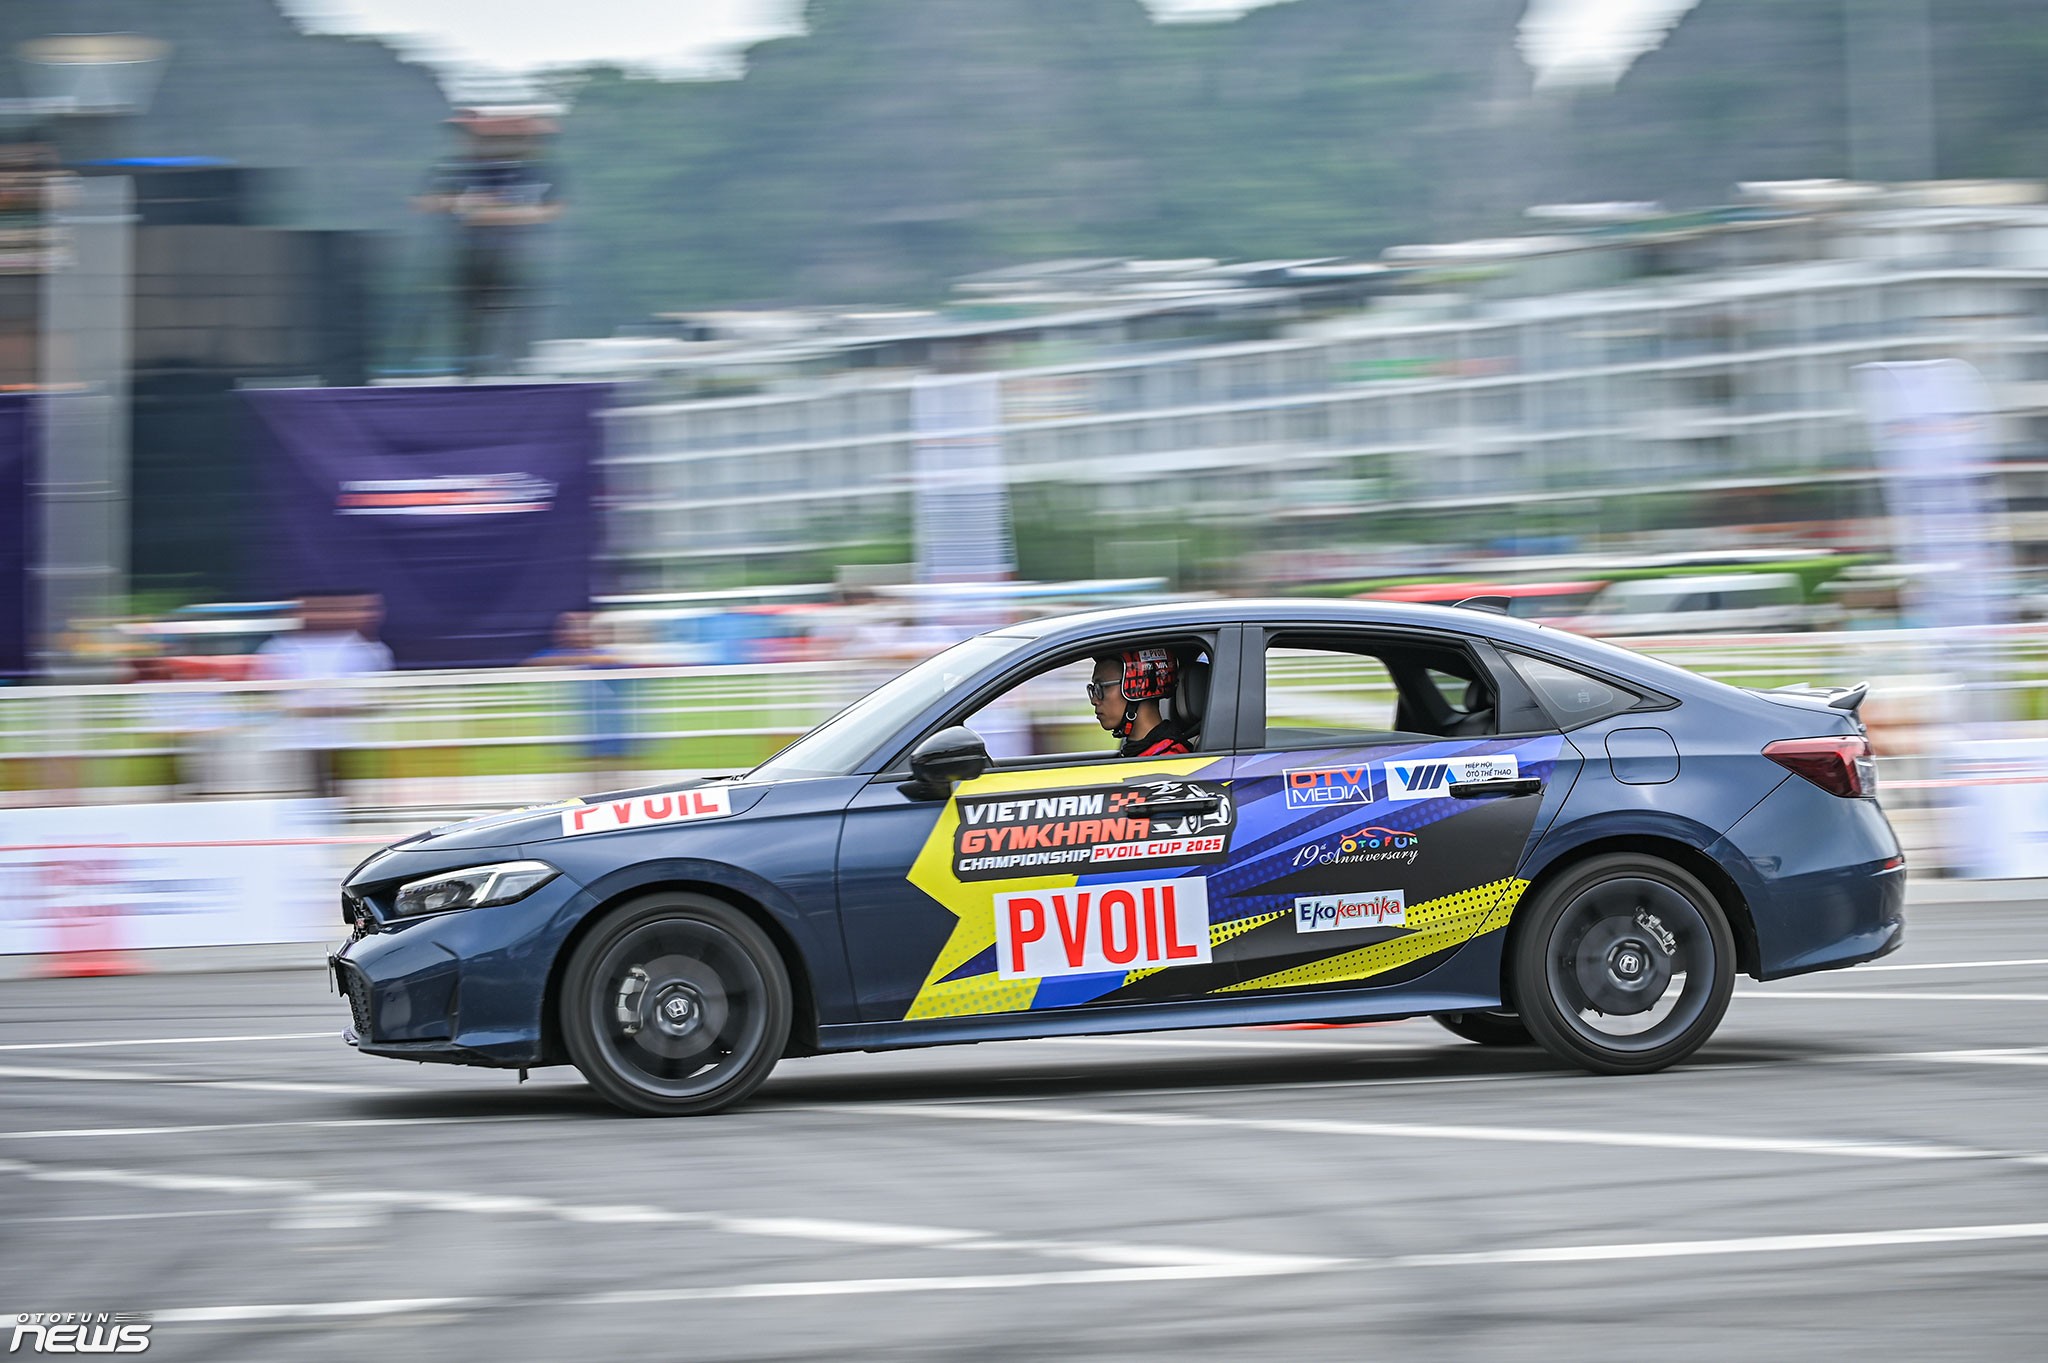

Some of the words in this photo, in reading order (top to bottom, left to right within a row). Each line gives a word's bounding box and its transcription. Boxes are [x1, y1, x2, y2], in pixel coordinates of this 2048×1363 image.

[1290, 767, 1365, 788] OTV
[1292, 785, 1369, 803] MEDIA
[964, 793, 1105, 825] VIETNAM
[960, 817, 1150, 854] GYMKHANA
[958, 849, 1092, 871] CHAMPIONSHIP
[1094, 843, 1143, 860] PVOIL
[1147, 841, 1182, 856] CUP
[1186, 838, 1222, 852] 2025
[1320, 847, 1420, 866] Anniversary
[1300, 896, 1401, 928] Ekokemika
[1008, 885, 1198, 972] PVOIL
